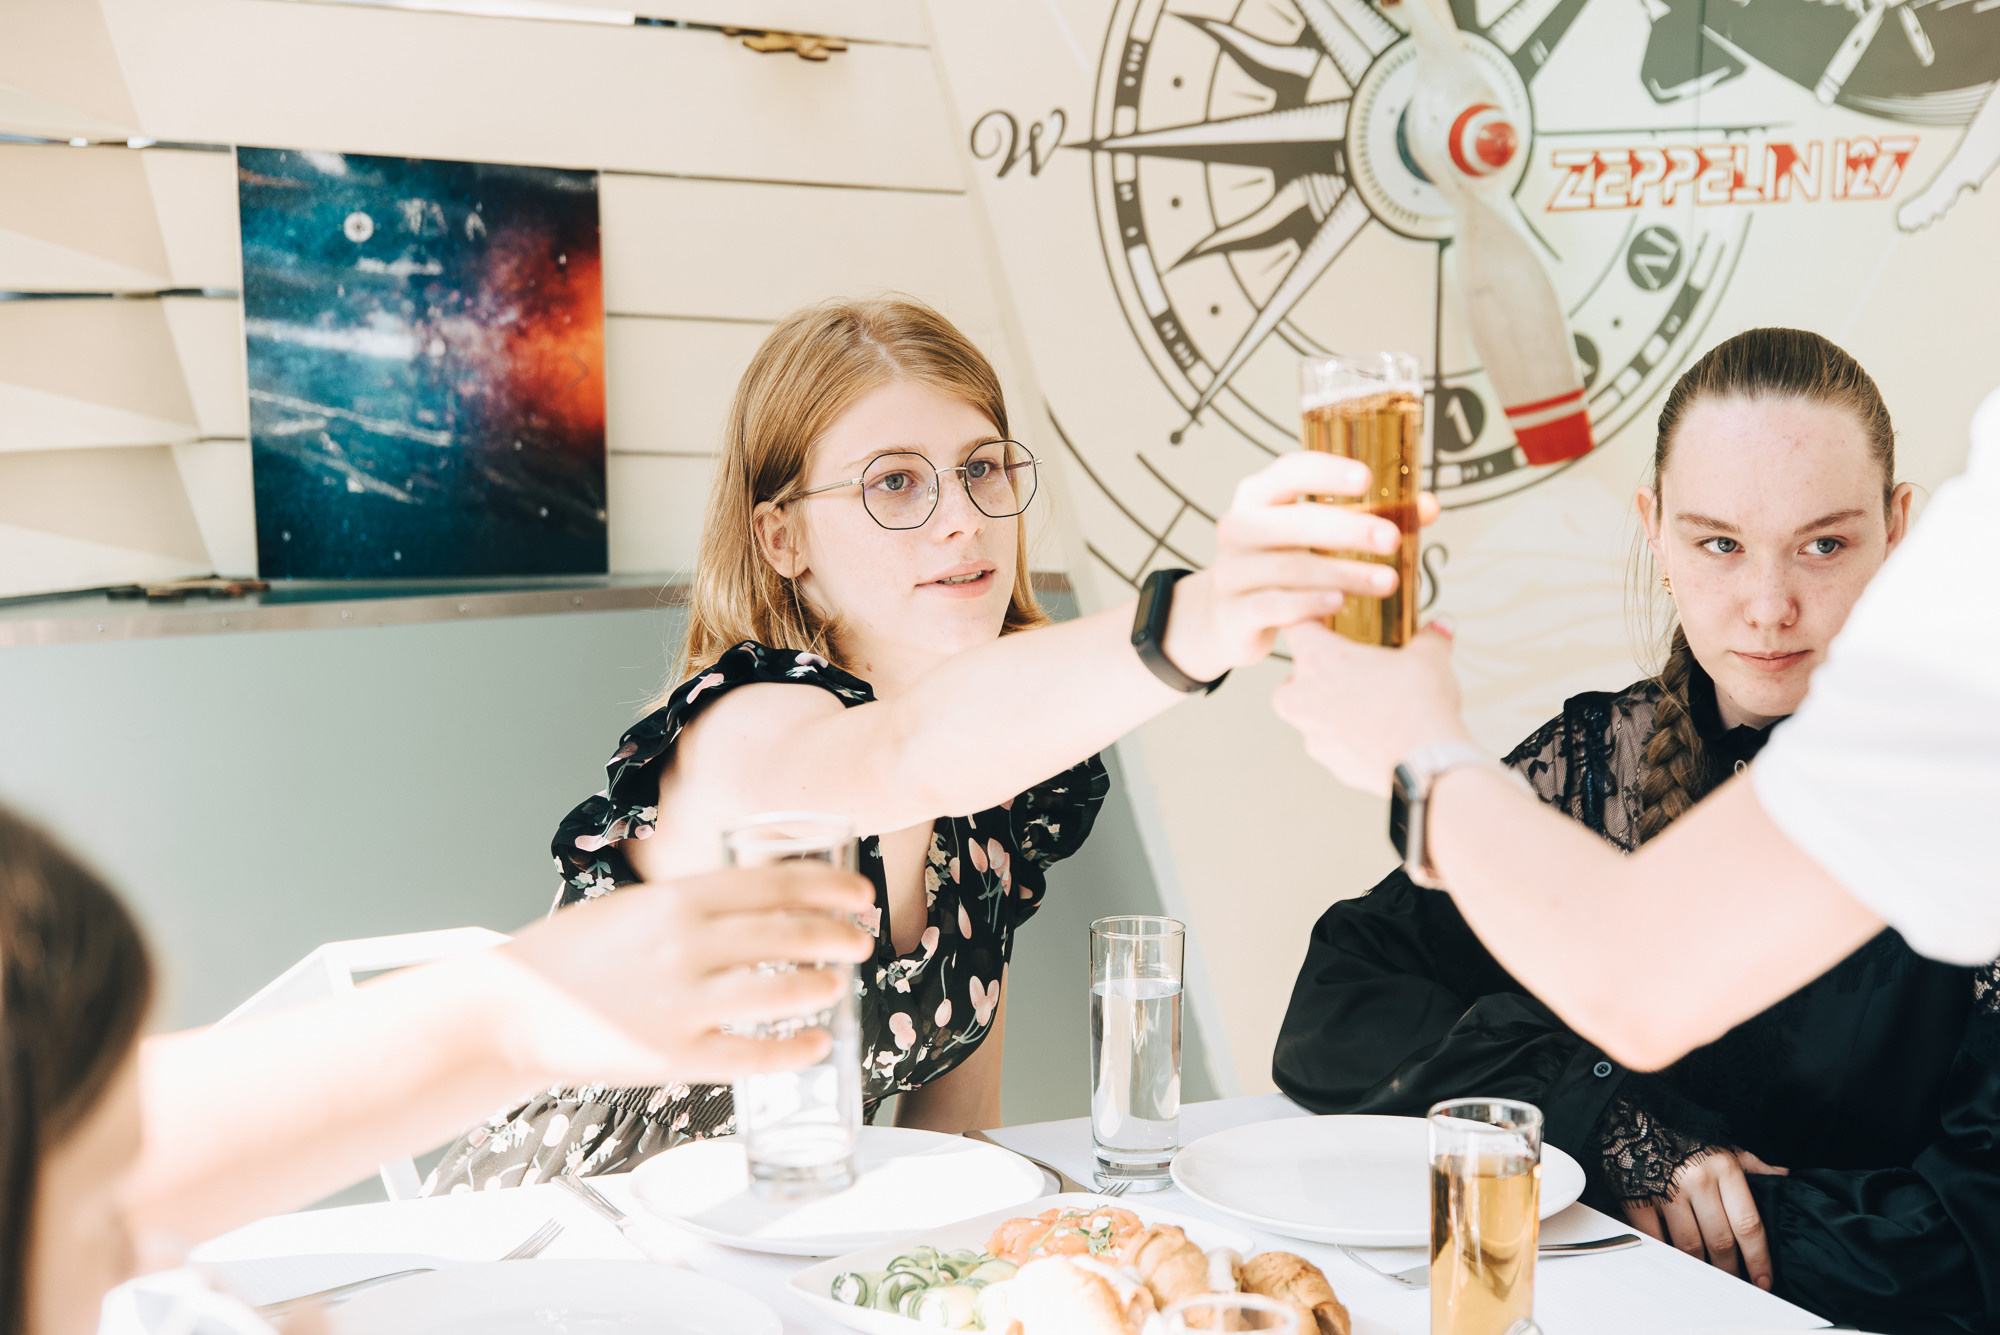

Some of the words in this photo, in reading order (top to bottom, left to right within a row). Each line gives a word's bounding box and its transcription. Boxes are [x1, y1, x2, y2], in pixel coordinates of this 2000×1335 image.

[971, 108, 1066, 178] W
[1546, 139, 1824, 212] ZEPPELIN
[1832, 134, 1920, 202] 127
